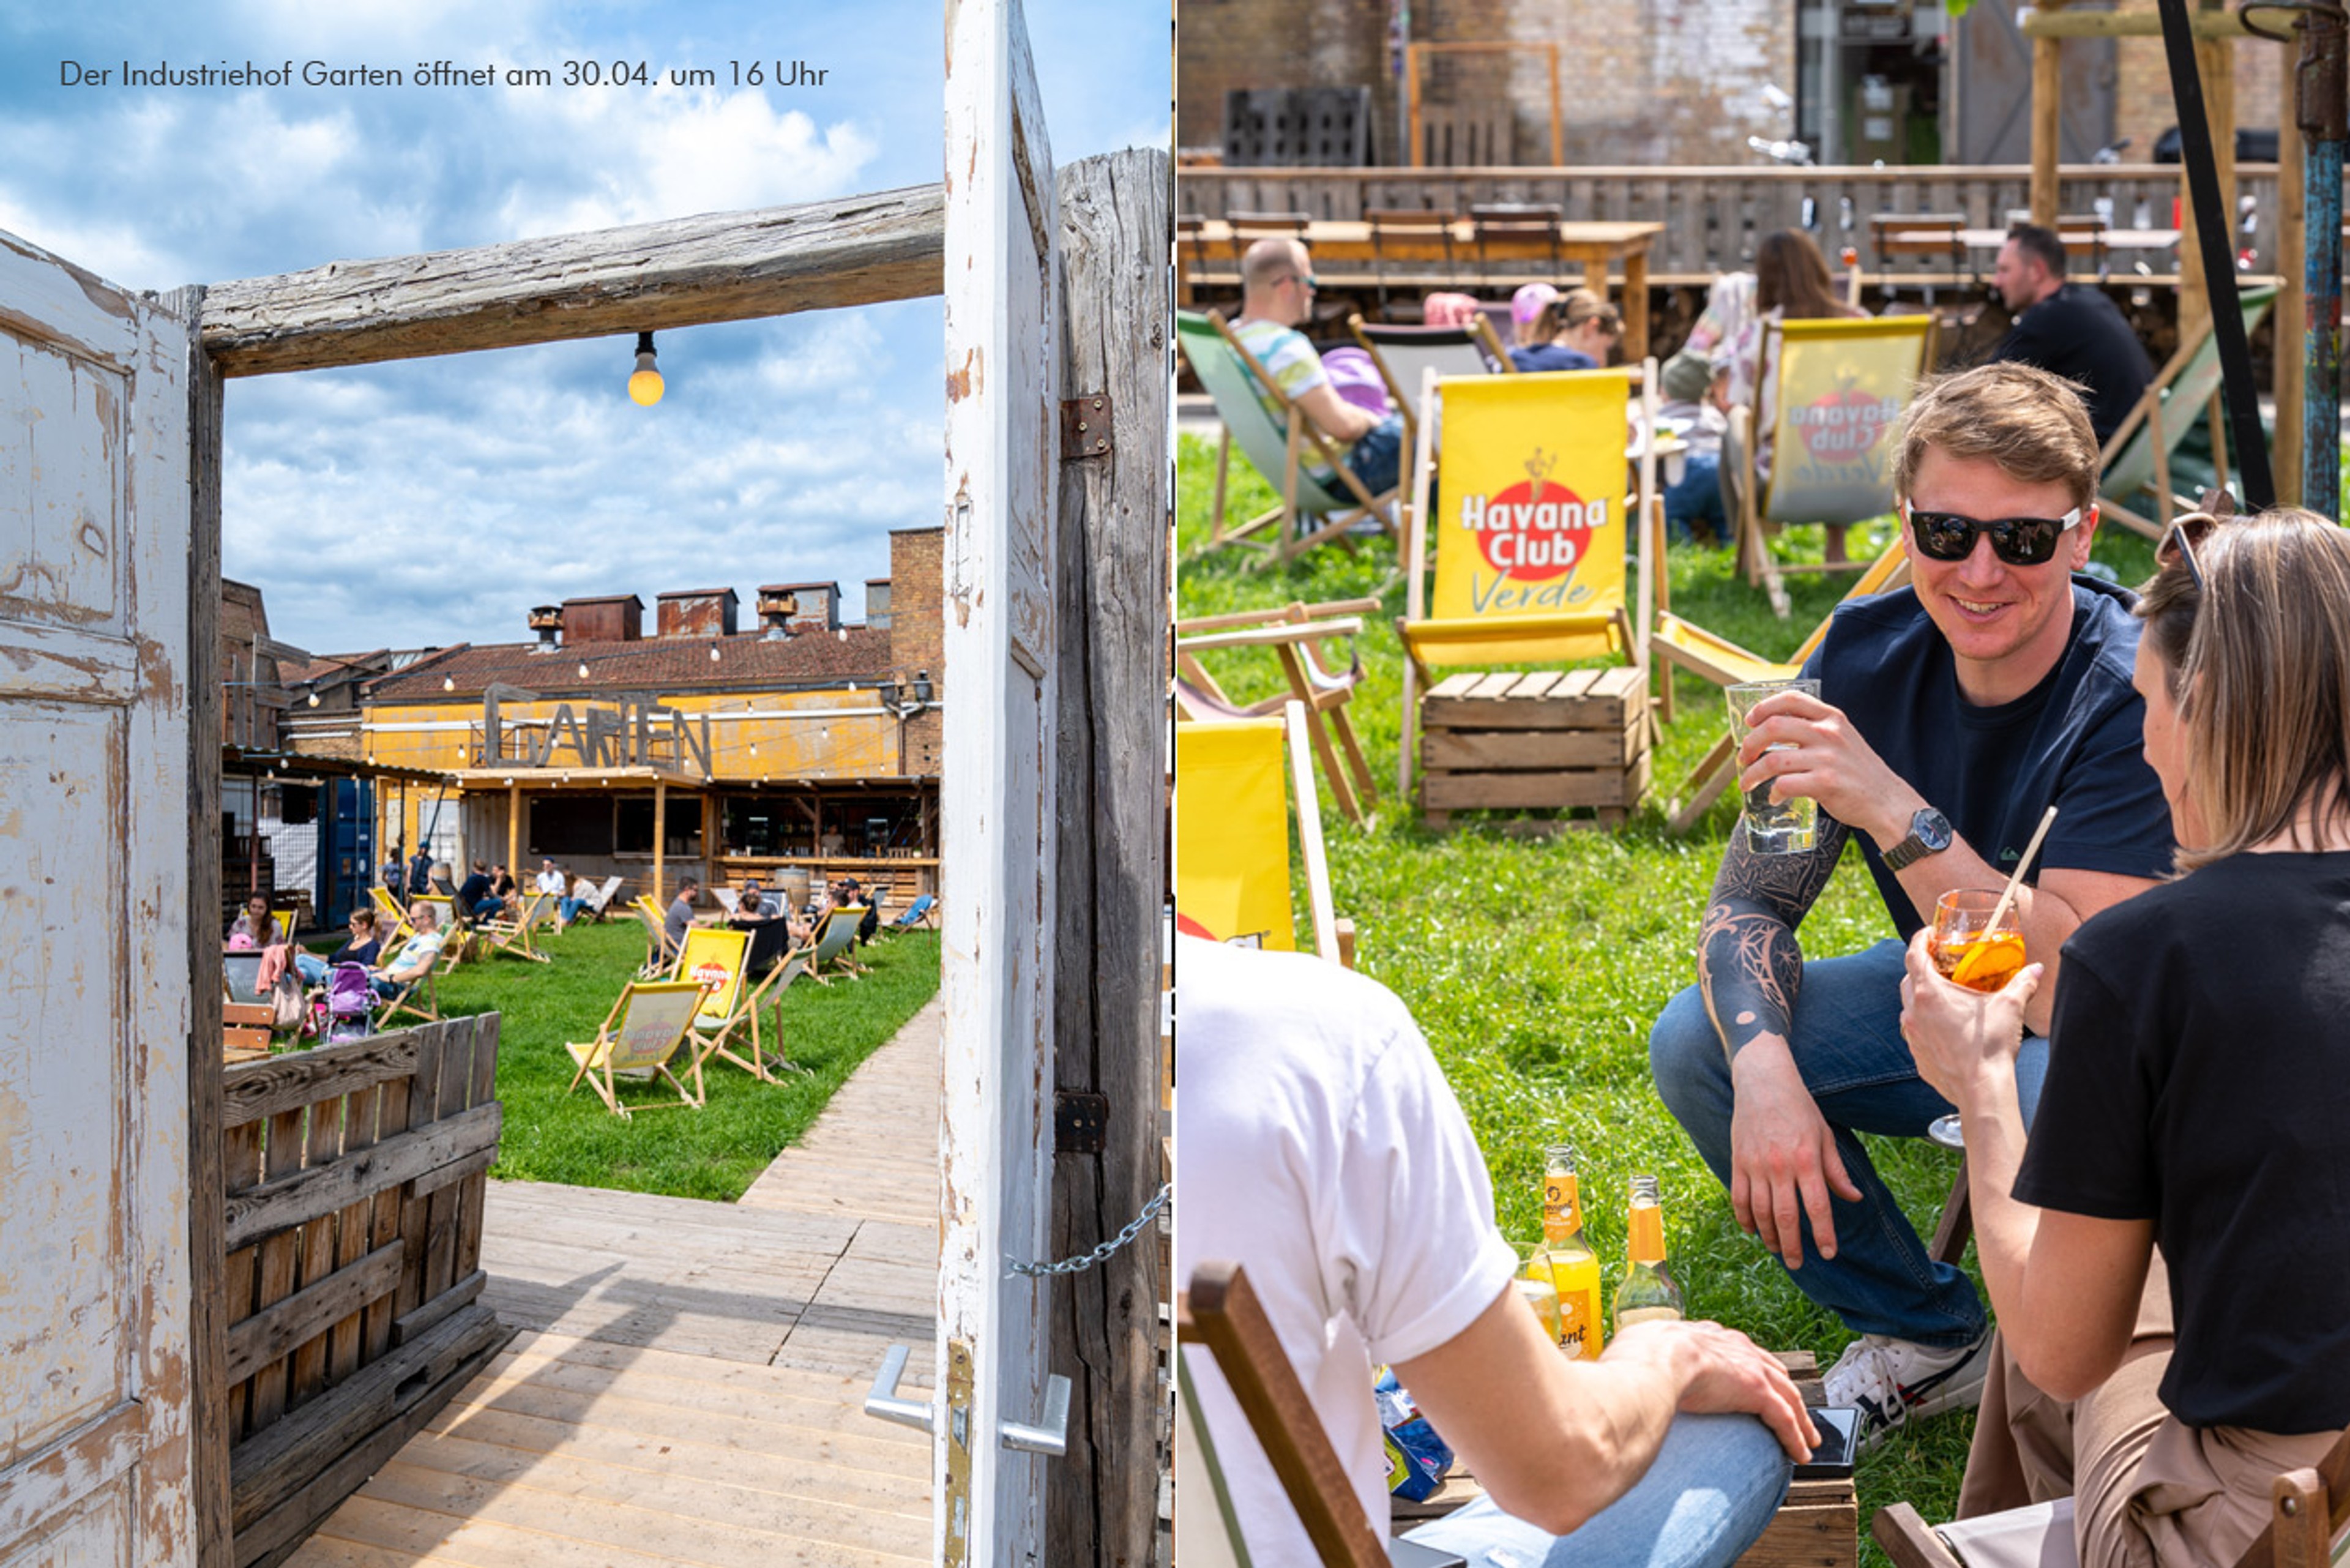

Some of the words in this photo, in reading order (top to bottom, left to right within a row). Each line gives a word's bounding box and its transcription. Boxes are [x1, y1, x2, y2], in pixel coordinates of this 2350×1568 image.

[1461, 494, 1608, 531] Havana
[1489, 532, 1576, 567] Club
[1472, 566, 1595, 614] Verde
